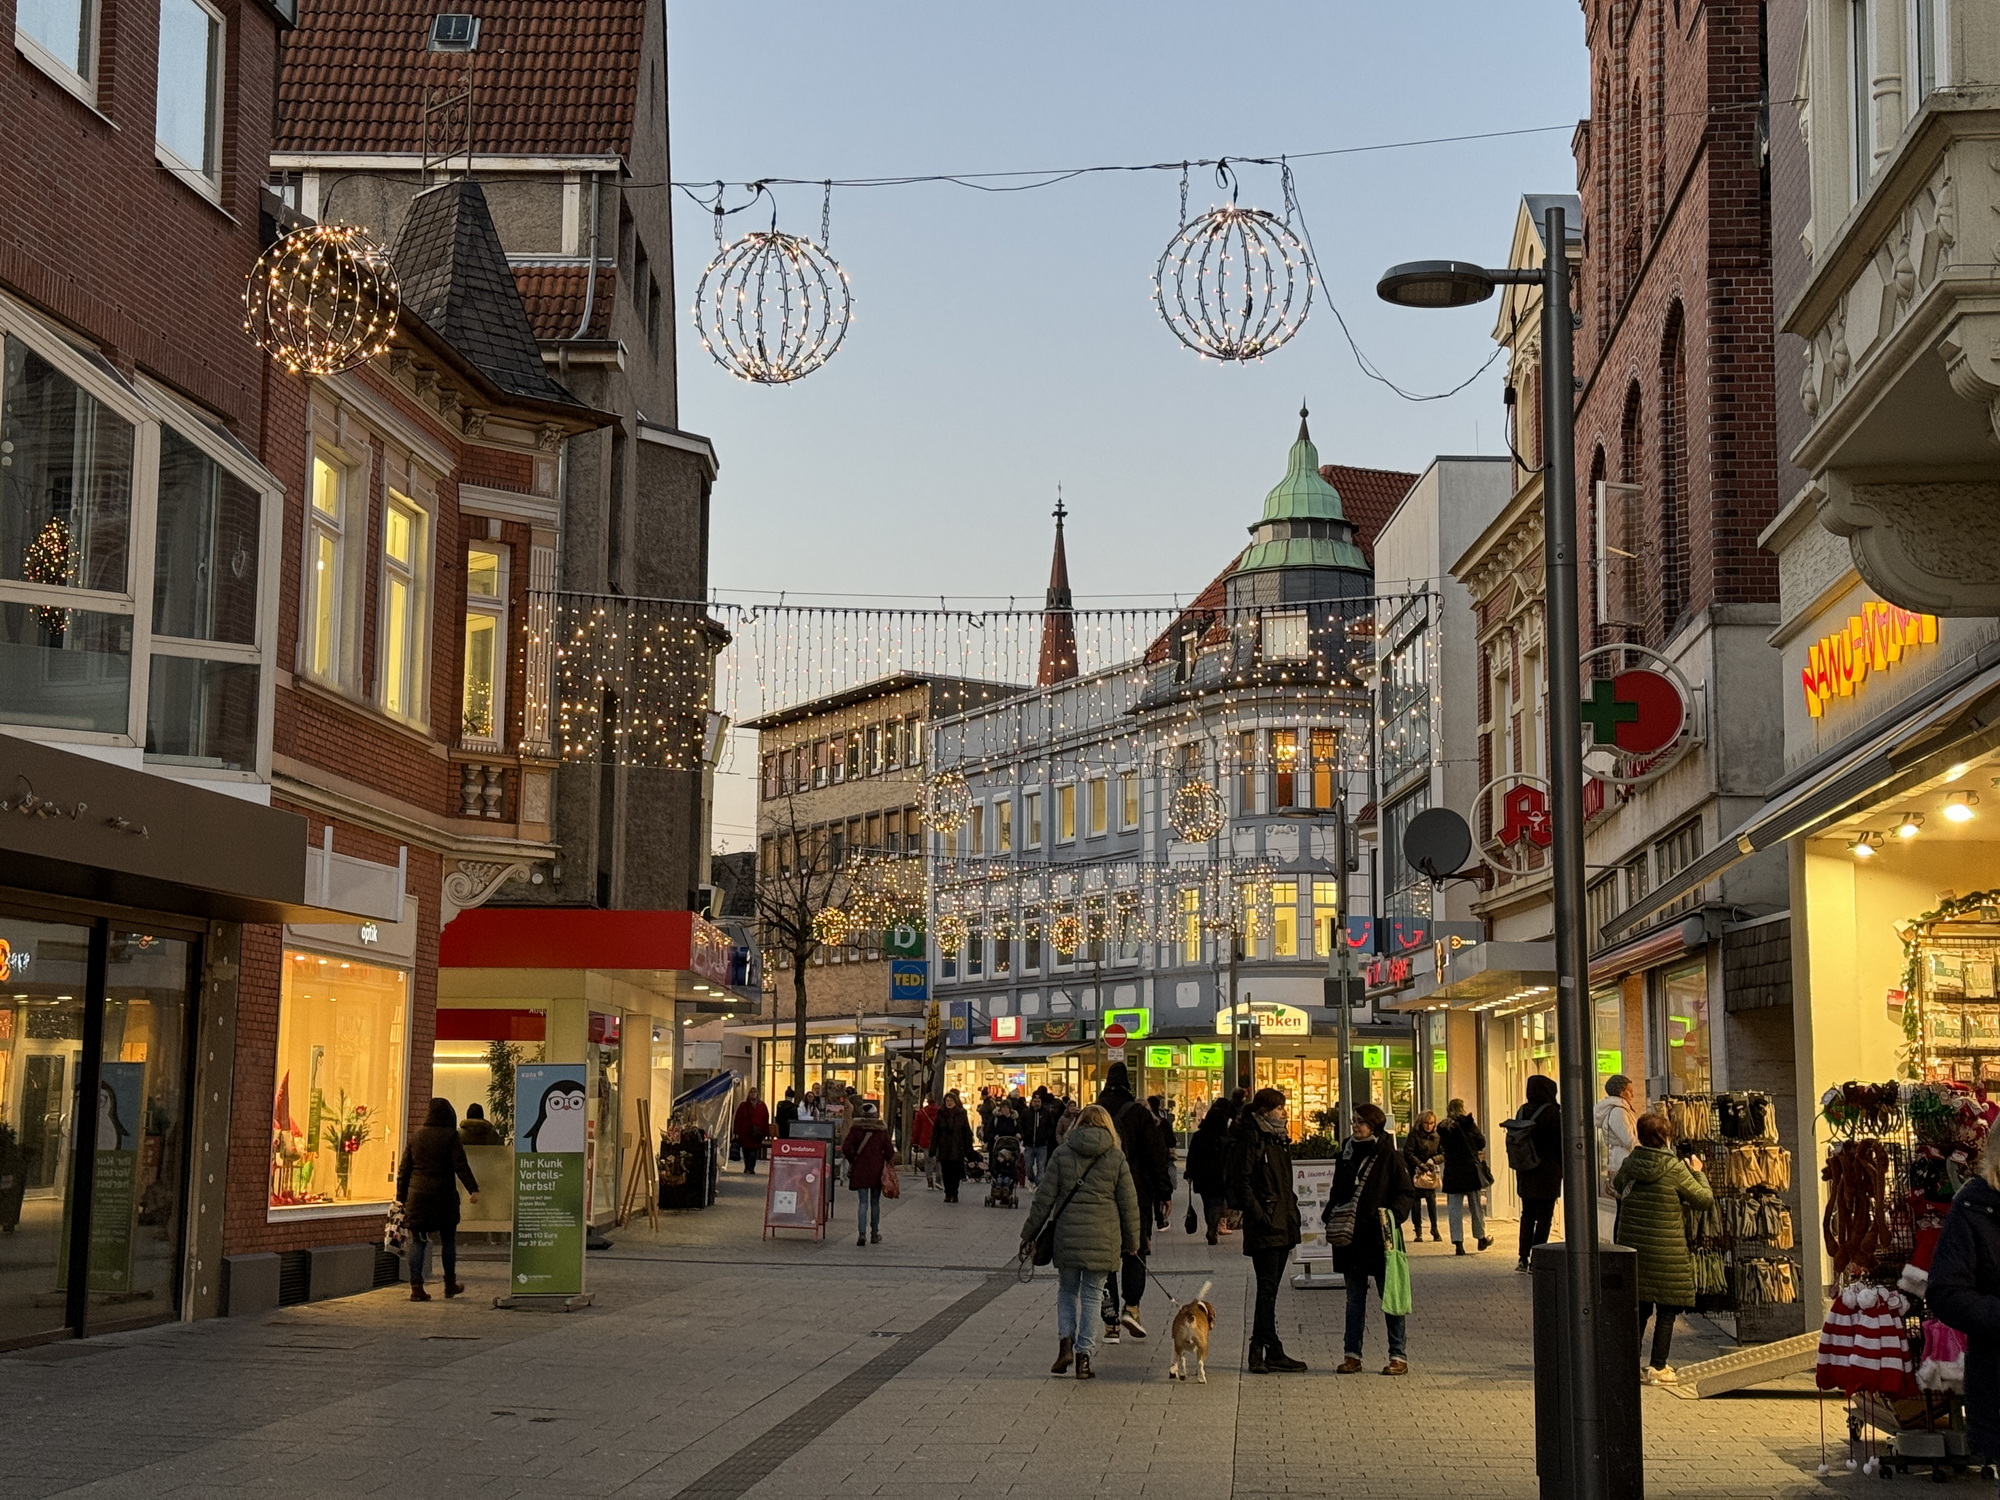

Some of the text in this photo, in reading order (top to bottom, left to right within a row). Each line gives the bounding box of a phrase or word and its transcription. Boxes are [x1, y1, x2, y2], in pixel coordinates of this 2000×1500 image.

[1801, 601, 1938, 718] NANU-NANA
[361, 923, 378, 945] optik
[894, 924, 916, 949] D
[893, 973, 925, 987] TEDi
[951, 1016, 966, 1030] TEDi
[1258, 1014, 1301, 1027] Ebken
[808, 1042, 869, 1059] DECHMAN
[520, 1158, 563, 1169] Ihr Kunk
[520, 1170, 564, 1180] Vorteils-
[519, 1181, 556, 1191] herbst!
